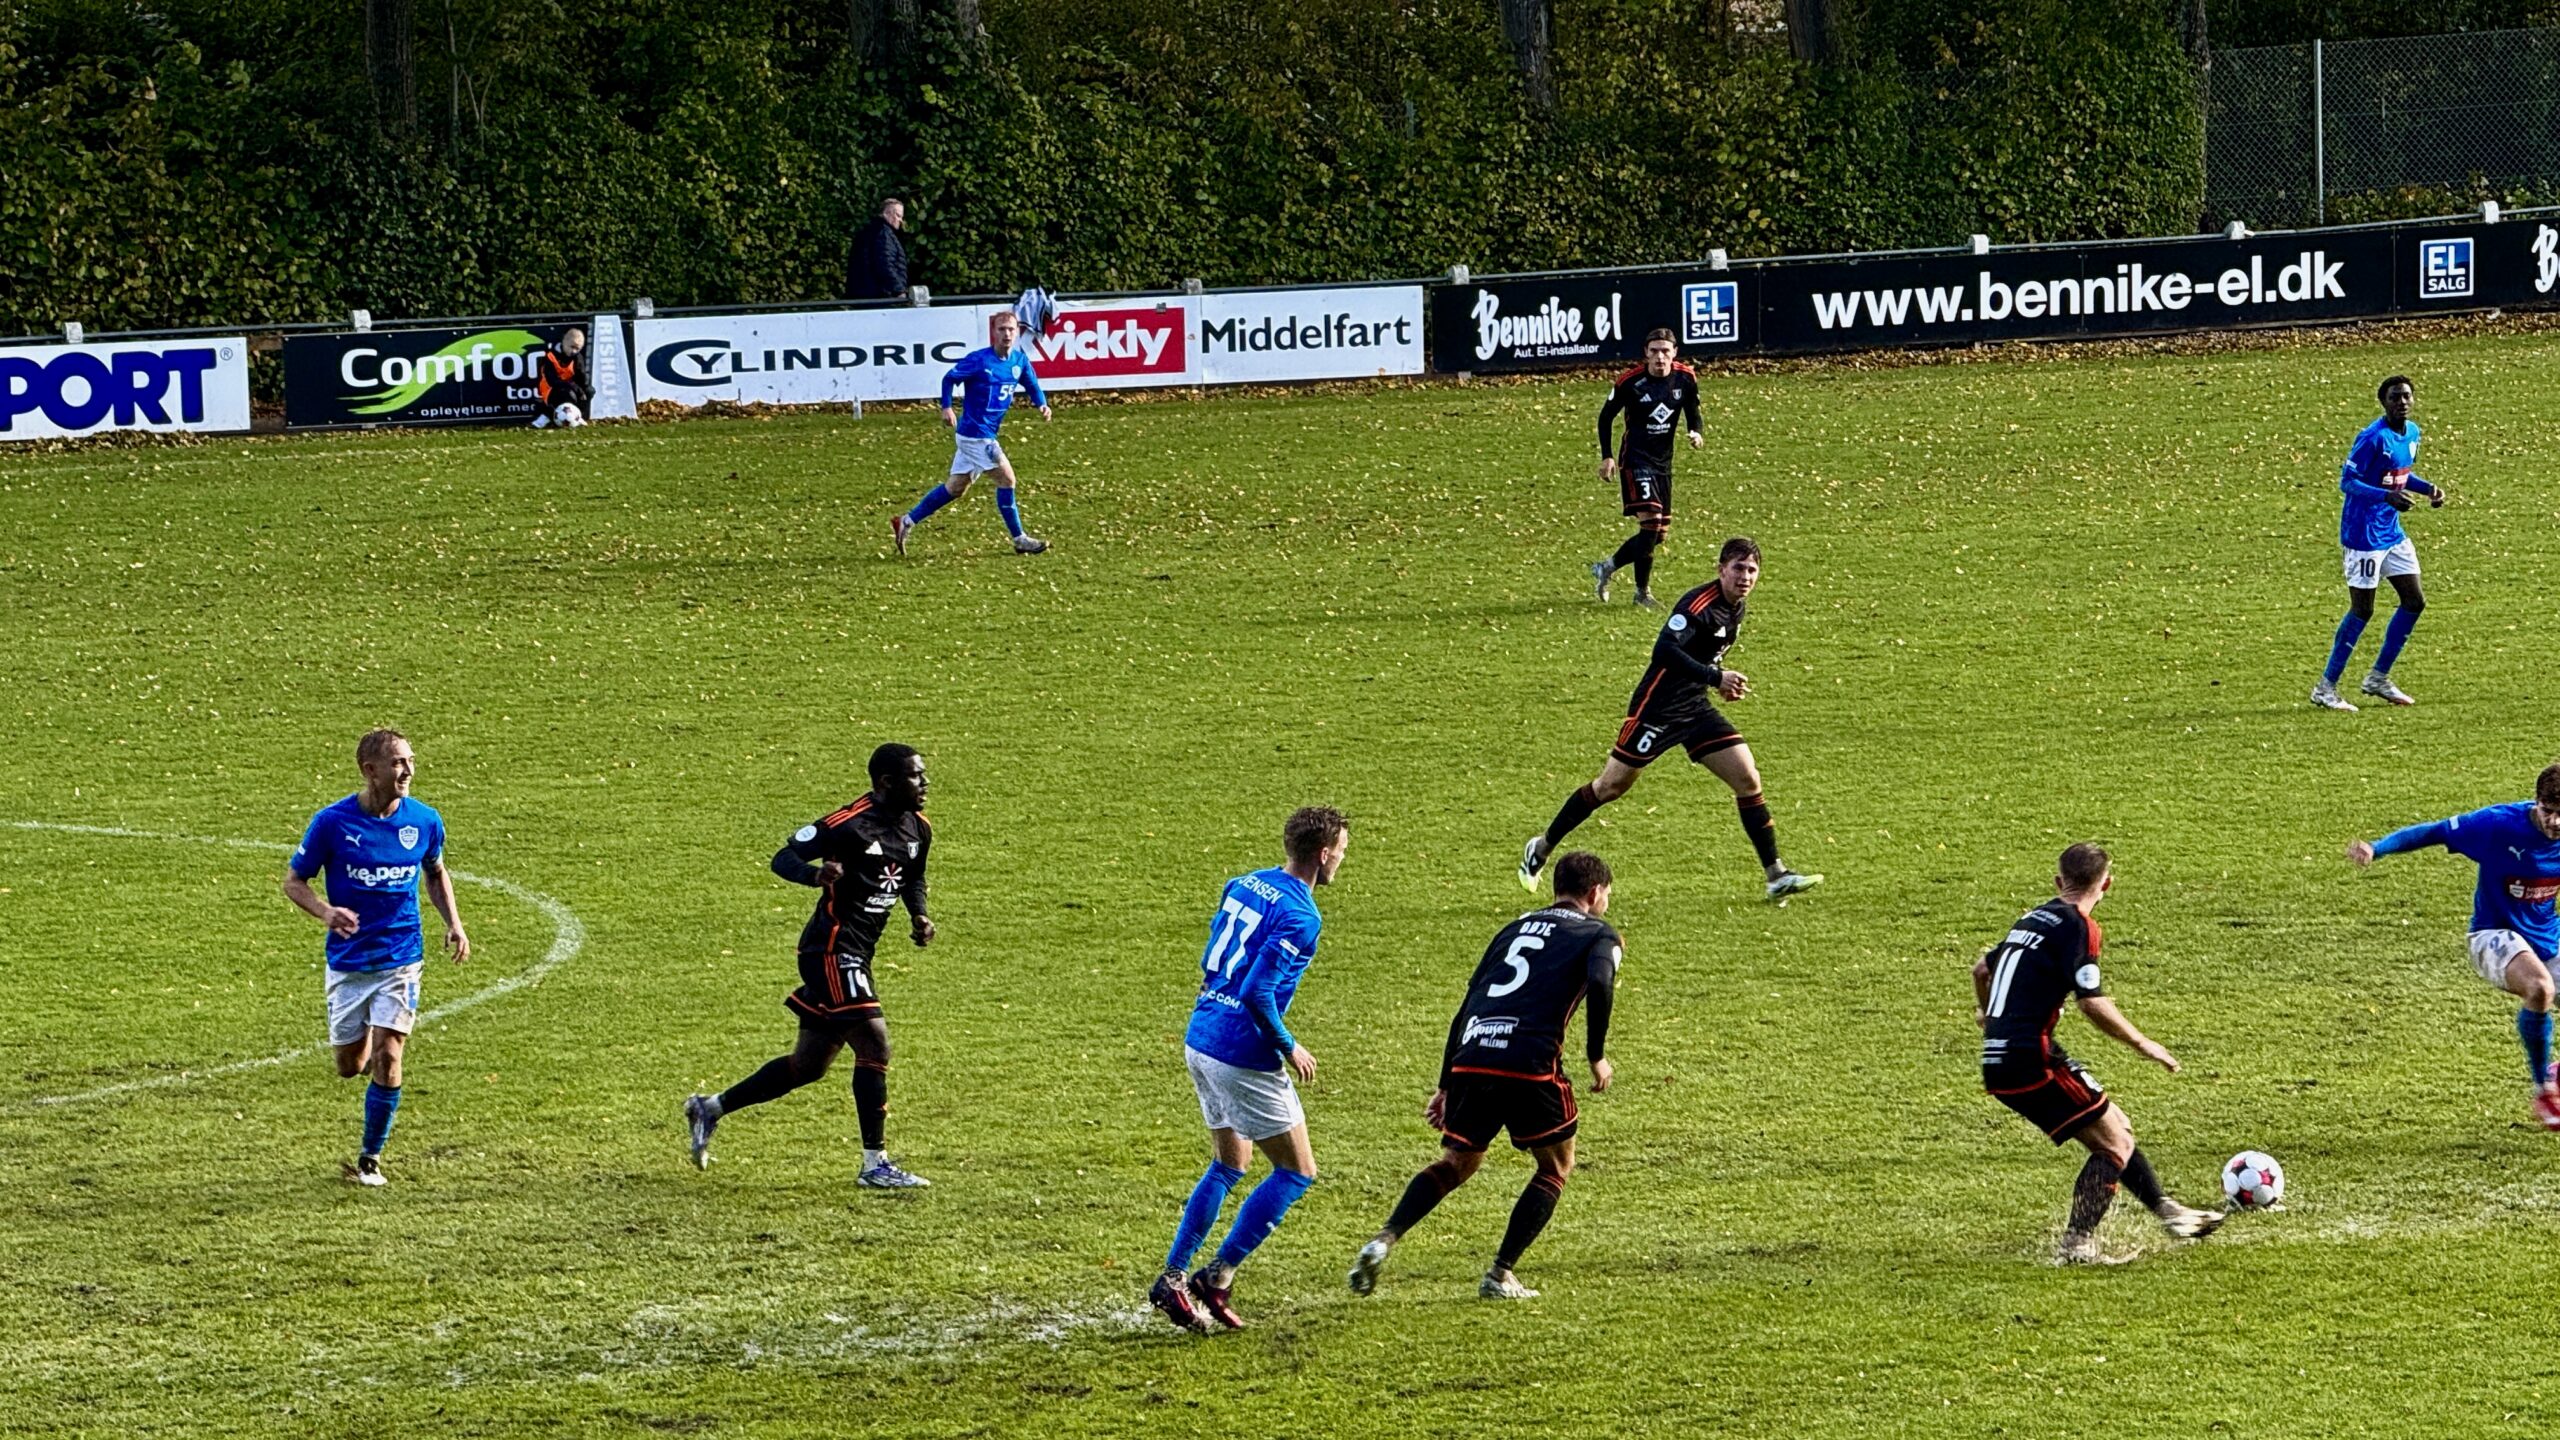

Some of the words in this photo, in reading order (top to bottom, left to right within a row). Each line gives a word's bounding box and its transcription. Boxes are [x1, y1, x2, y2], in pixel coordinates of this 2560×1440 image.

[2428, 245, 2466, 277] EL
[2531, 224, 2560, 293] B
[1812, 251, 2346, 329] www.bennike-el.dk
[2428, 277, 2466, 291] SALG
[1691, 290, 1730, 321] EL
[1202, 313, 1412, 353] Middelfart
[1471, 289, 1583, 361] Bennike
[1595, 292, 1623, 341] el
[1691, 321, 1731, 338] SALG
[341, 342, 552, 388] Comfor
[646, 340, 967, 387] CYLINDRIC
[1514, 347, 1534, 359] Aut.
[1640, 482, 1651, 500] 3
[2359, 558, 2376, 578] 10
[1636, 730, 1656, 753] 6
[1207, 896, 1263, 981] 77
[847, 969, 873, 998] 14
[1487, 936, 1545, 998] 5
[1986, 946, 2025, 1018] 11
